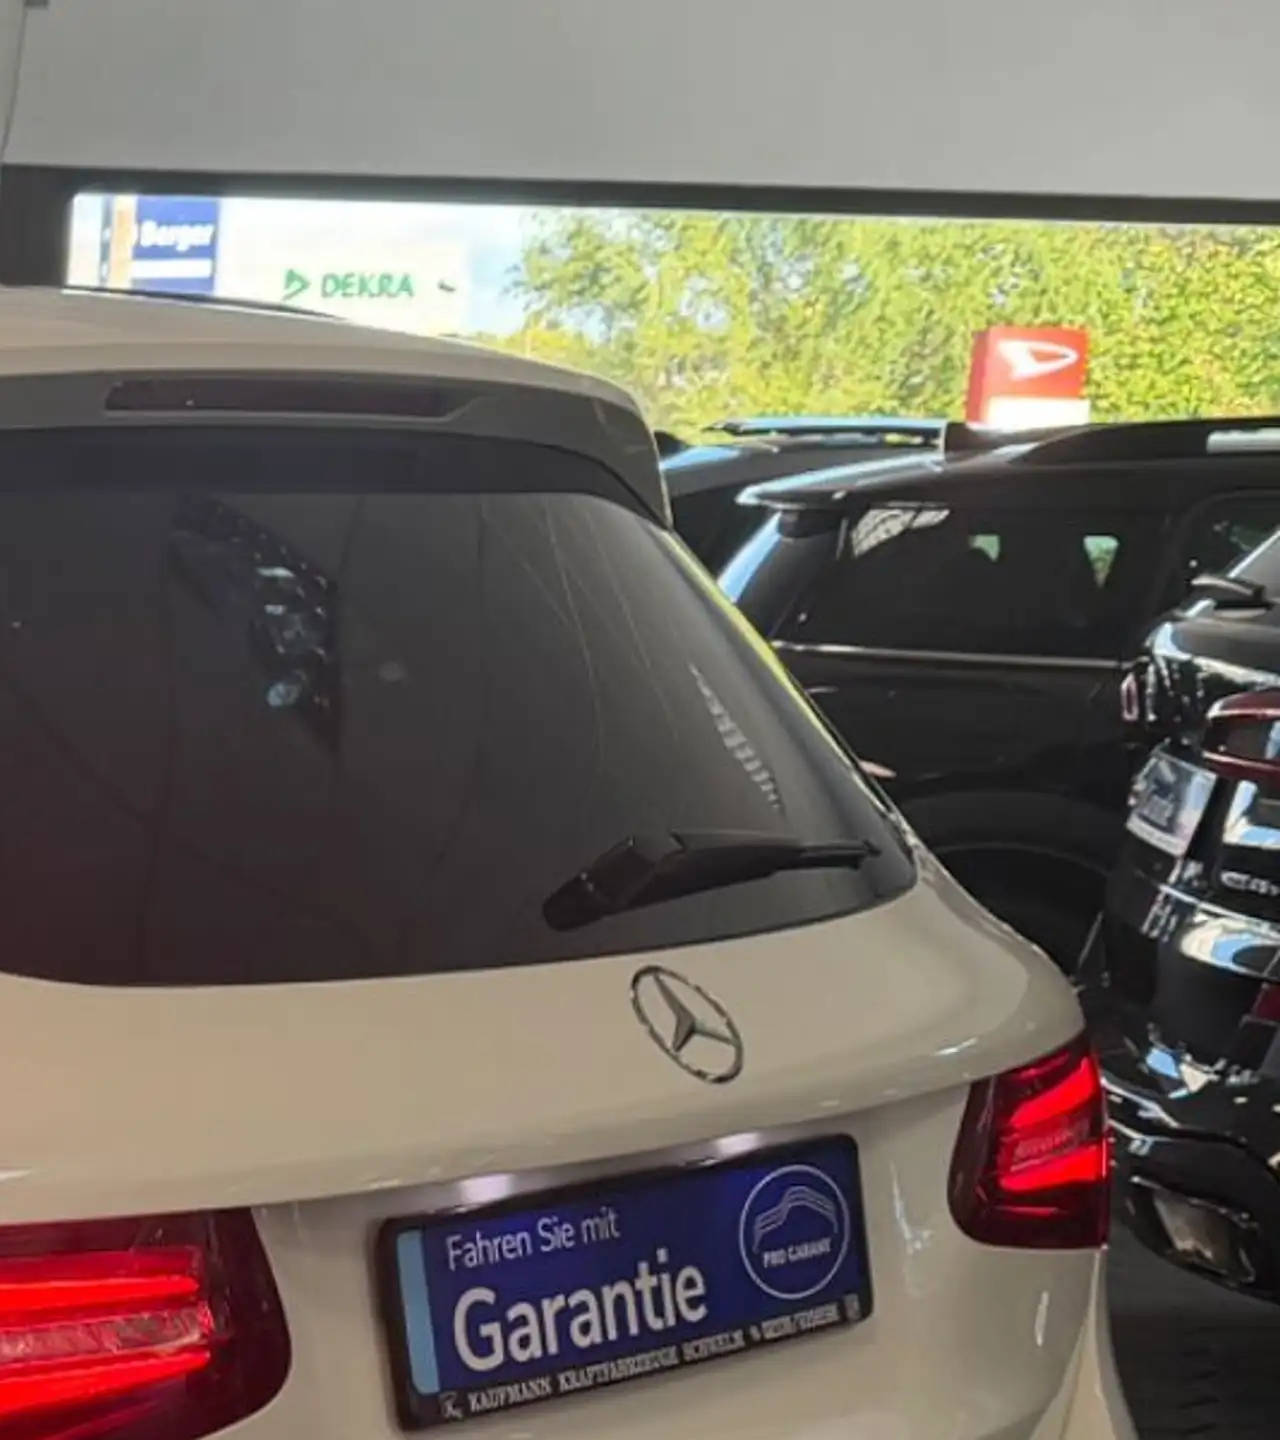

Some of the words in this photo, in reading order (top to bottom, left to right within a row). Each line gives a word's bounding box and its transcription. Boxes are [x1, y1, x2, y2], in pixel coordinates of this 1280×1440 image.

[320, 271, 415, 298] DEKRA
[445, 1230, 532, 1271] Fahren
[537, 1216, 576, 1251] Sie
[581, 1206, 621, 1243] mit
[453, 1247, 708, 1372] Garantie
[467, 1375, 553, 1413] KAUFMANN
